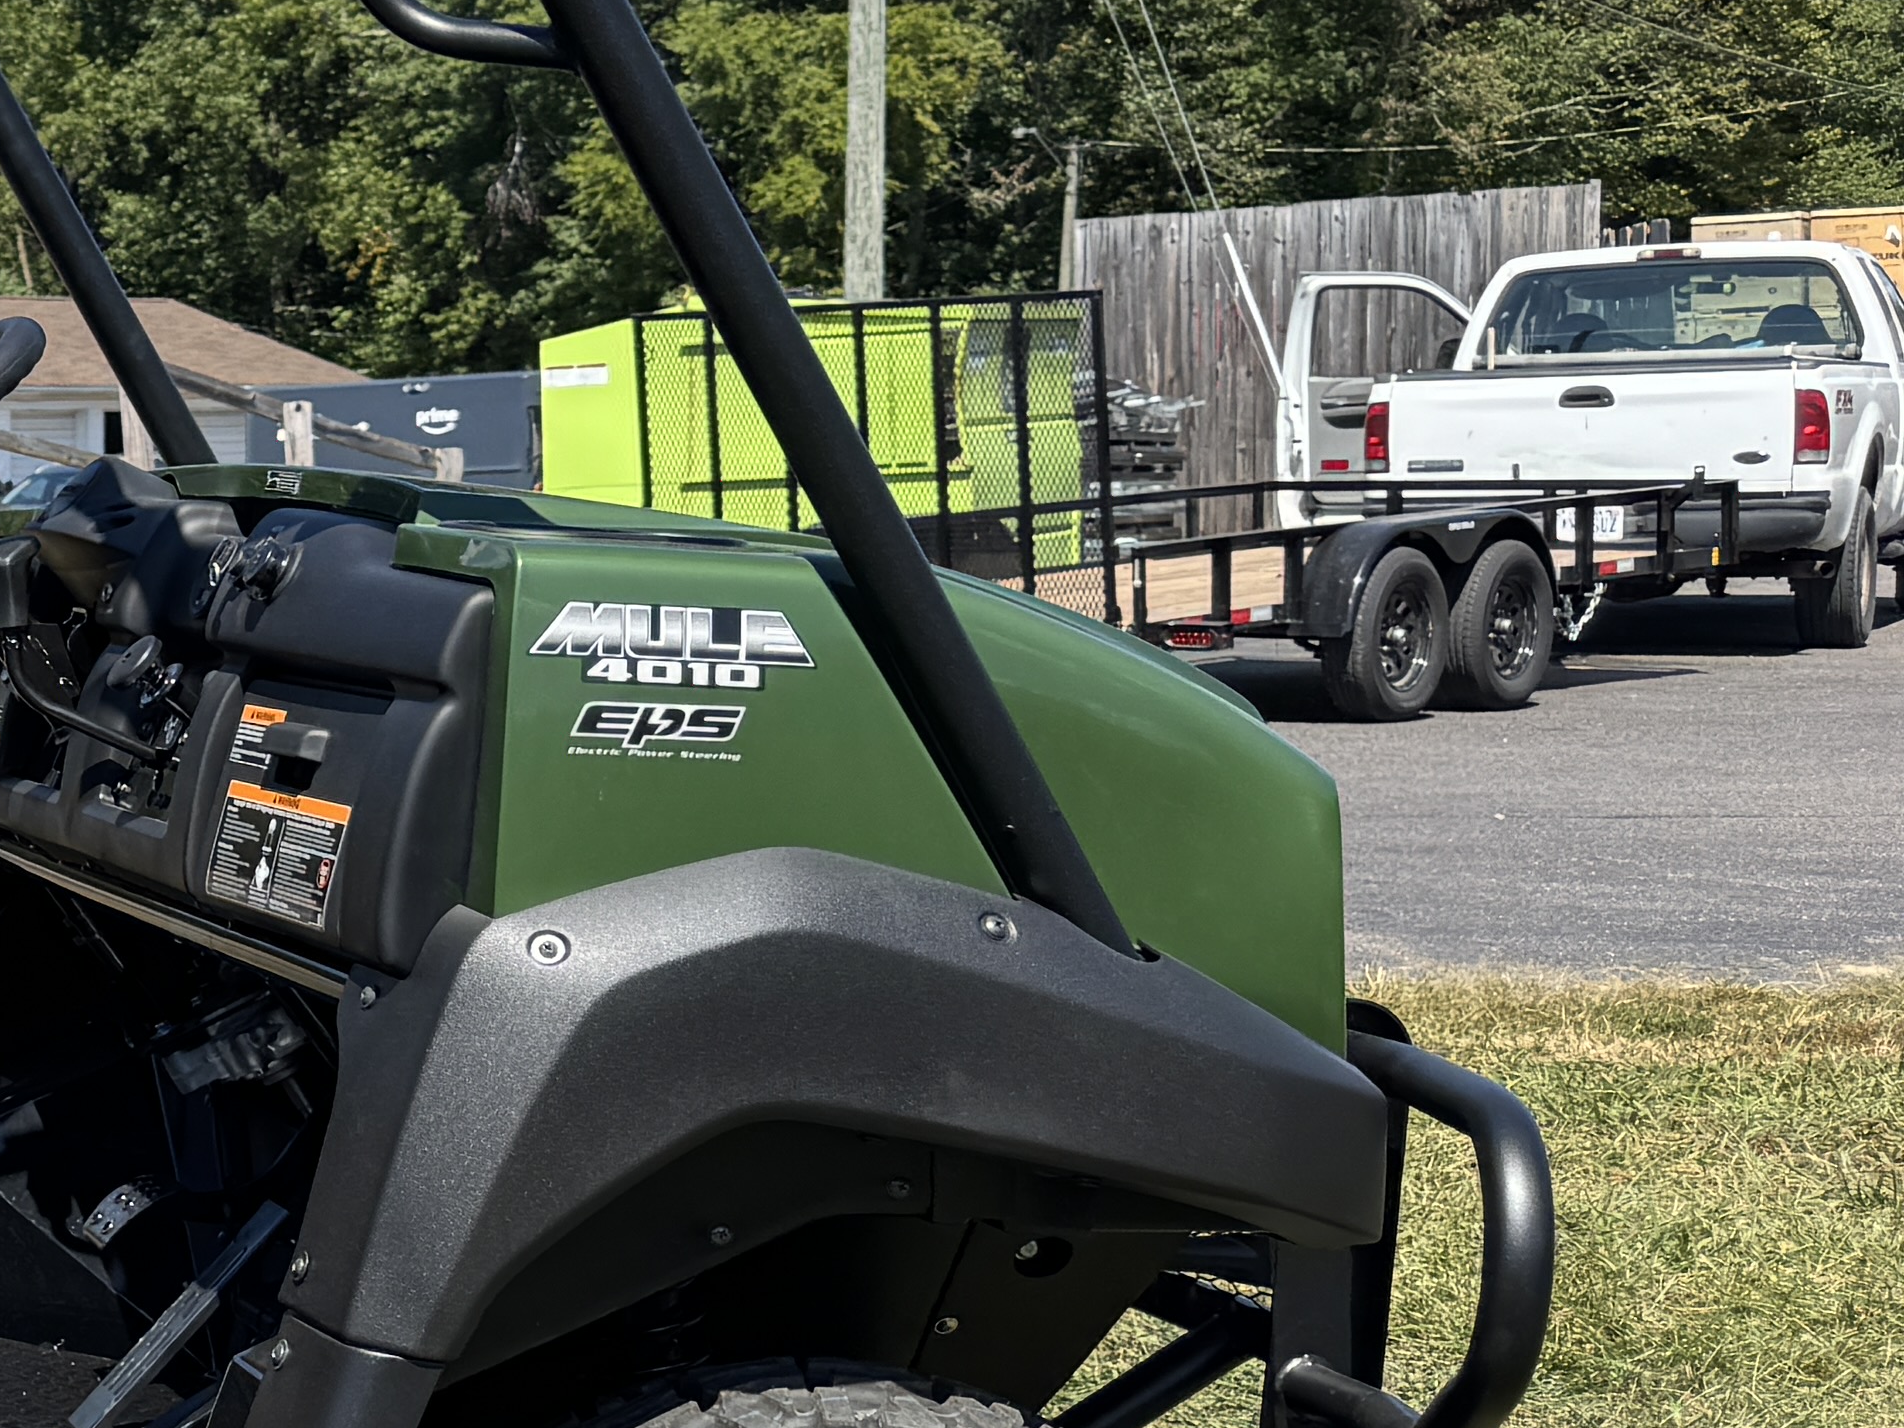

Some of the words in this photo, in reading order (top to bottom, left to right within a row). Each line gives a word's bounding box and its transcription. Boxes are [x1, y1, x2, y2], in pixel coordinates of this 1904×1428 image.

[529, 601, 816, 668] MULE
[586, 658, 761, 687] 4010
[569, 701, 747, 749] EPS
[628, 748, 674, 758] Power
[680, 750, 742, 762] Steering
